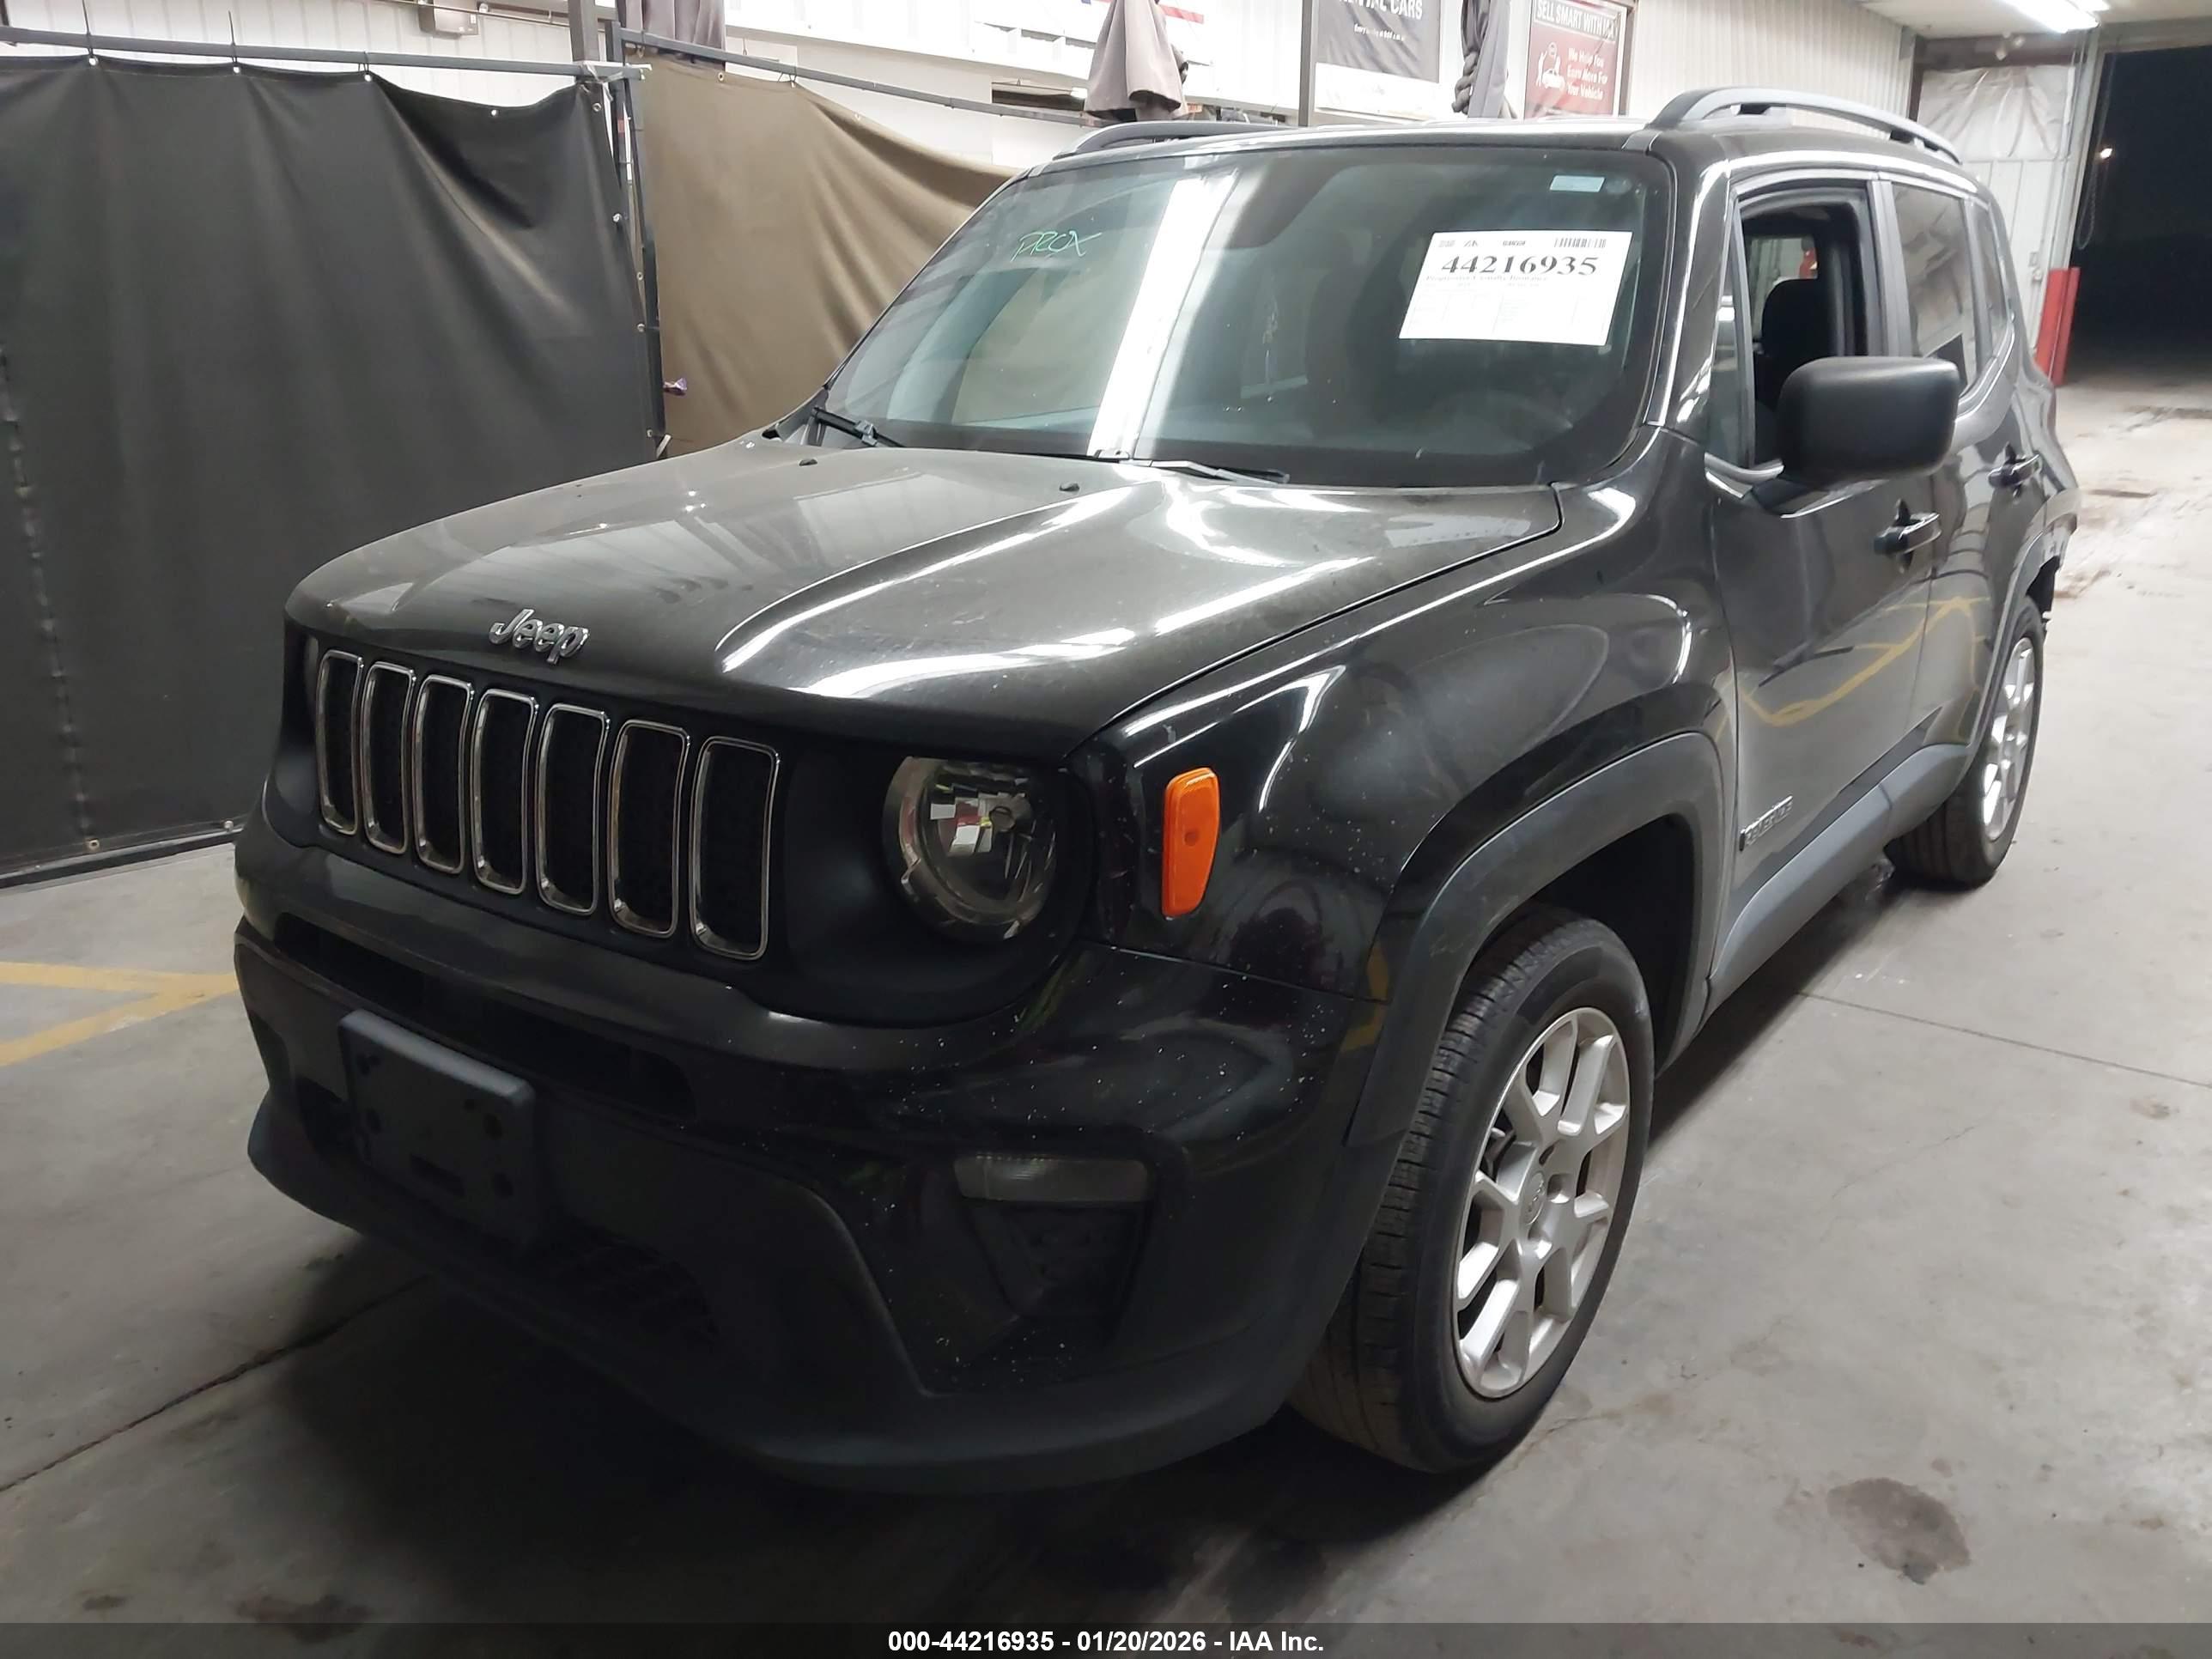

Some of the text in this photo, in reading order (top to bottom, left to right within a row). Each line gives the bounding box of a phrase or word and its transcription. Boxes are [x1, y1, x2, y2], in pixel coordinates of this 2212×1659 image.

[1537, 0, 1554, 21] SELL
[1556, 4, 1583, 29] SMART
[1583, 13, 1603, 36] WITH
[1441, 255, 1599, 276] 44216935
[489, 608, 589, 665] Jeep
